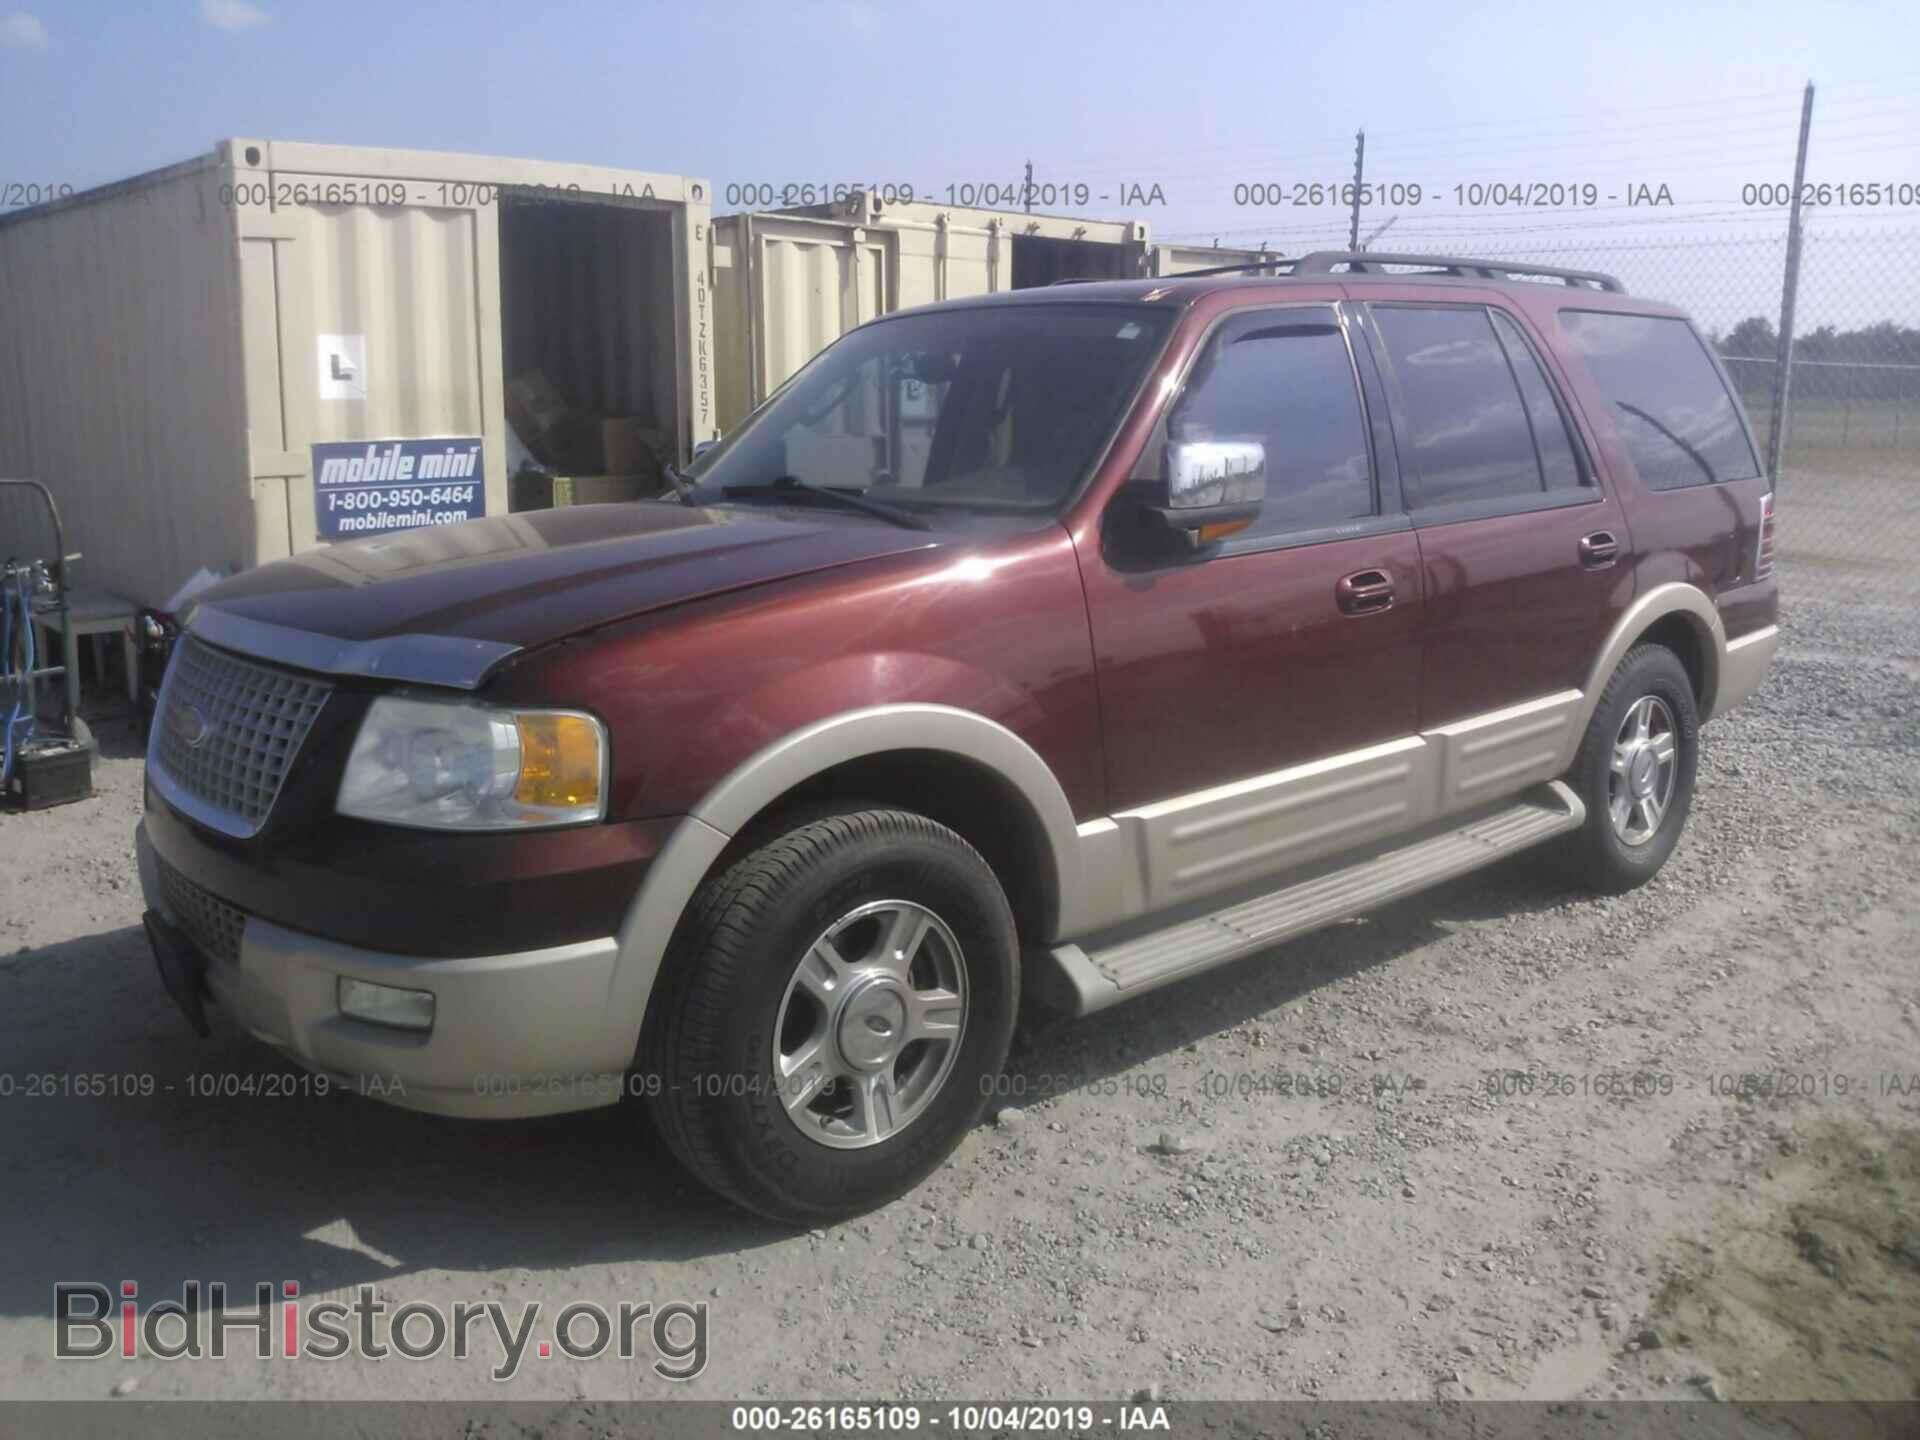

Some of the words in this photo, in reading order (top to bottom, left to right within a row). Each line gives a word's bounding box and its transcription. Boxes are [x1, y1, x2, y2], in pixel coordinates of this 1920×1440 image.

[320, 444, 416, 484] mobile
[417, 447, 478, 479] mini
[328, 486, 474, 511] 1-800-950-6464
[338, 509, 468, 531] mobilemini.com
